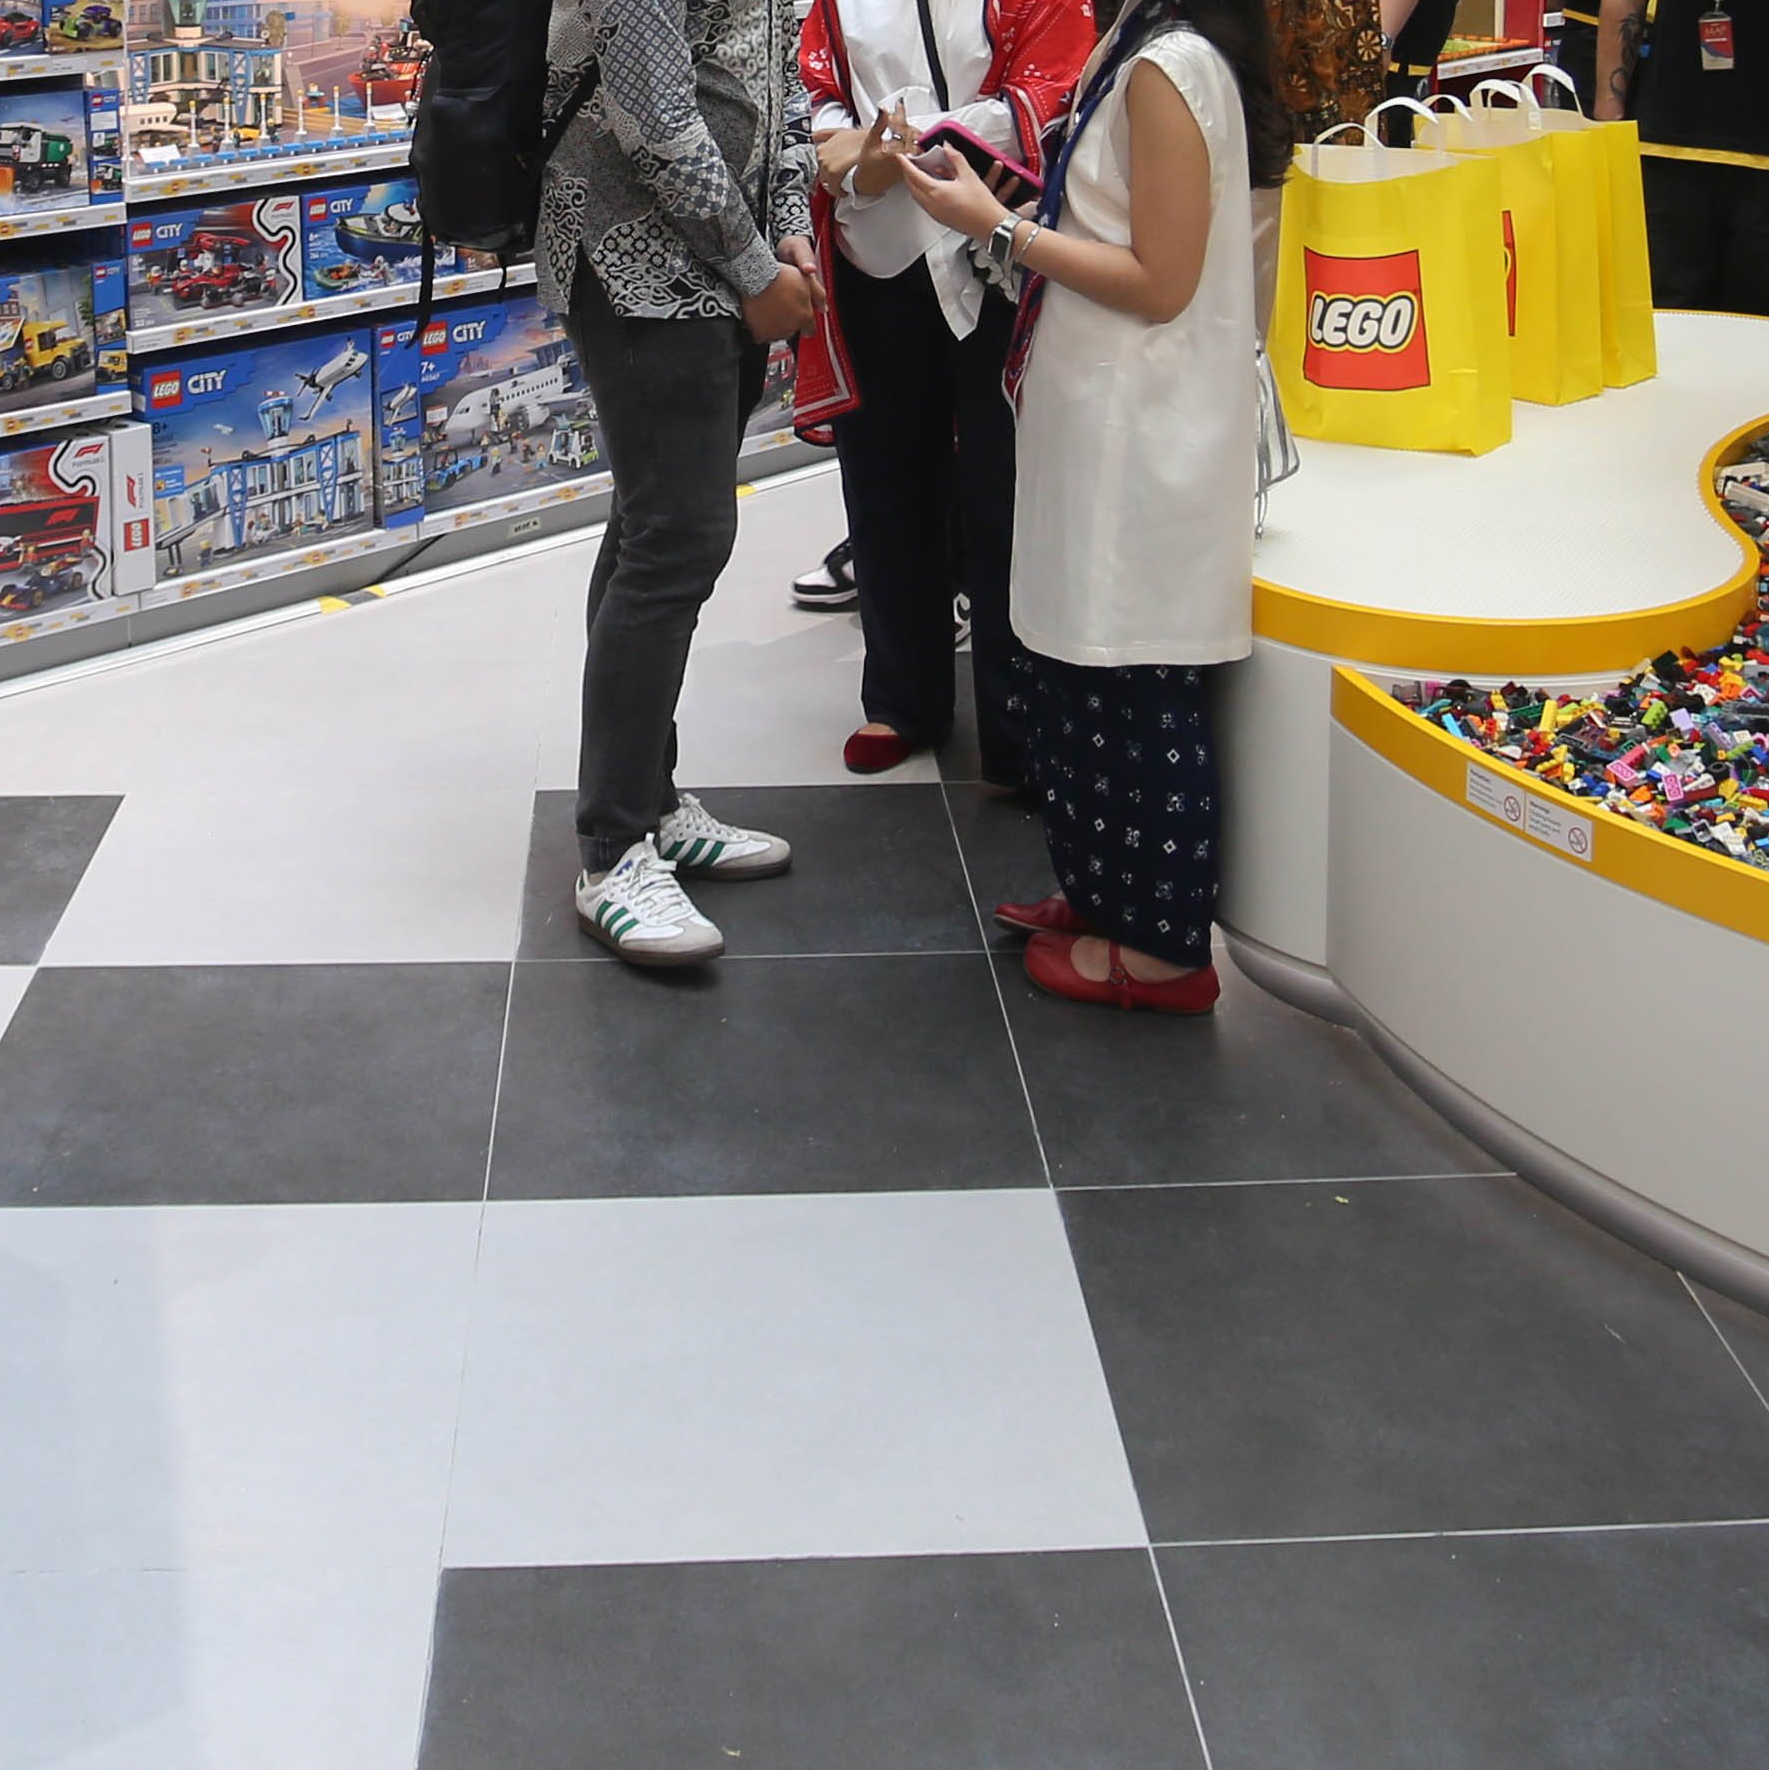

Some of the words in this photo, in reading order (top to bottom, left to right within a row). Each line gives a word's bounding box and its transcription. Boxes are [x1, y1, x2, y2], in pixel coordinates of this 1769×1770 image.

[331, 199, 353, 213] CITY
[133, 228, 151, 241] LEGO
[156, 223, 183, 239] CITY
[1310, 296, 1415, 349] LEGO
[422, 332, 446, 346] LEGO
[453, 321, 485, 342] CITY
[420, 361, 436, 374] 7+
[152, 382, 180, 399] LEGO
[187, 369, 226, 393] CITY
